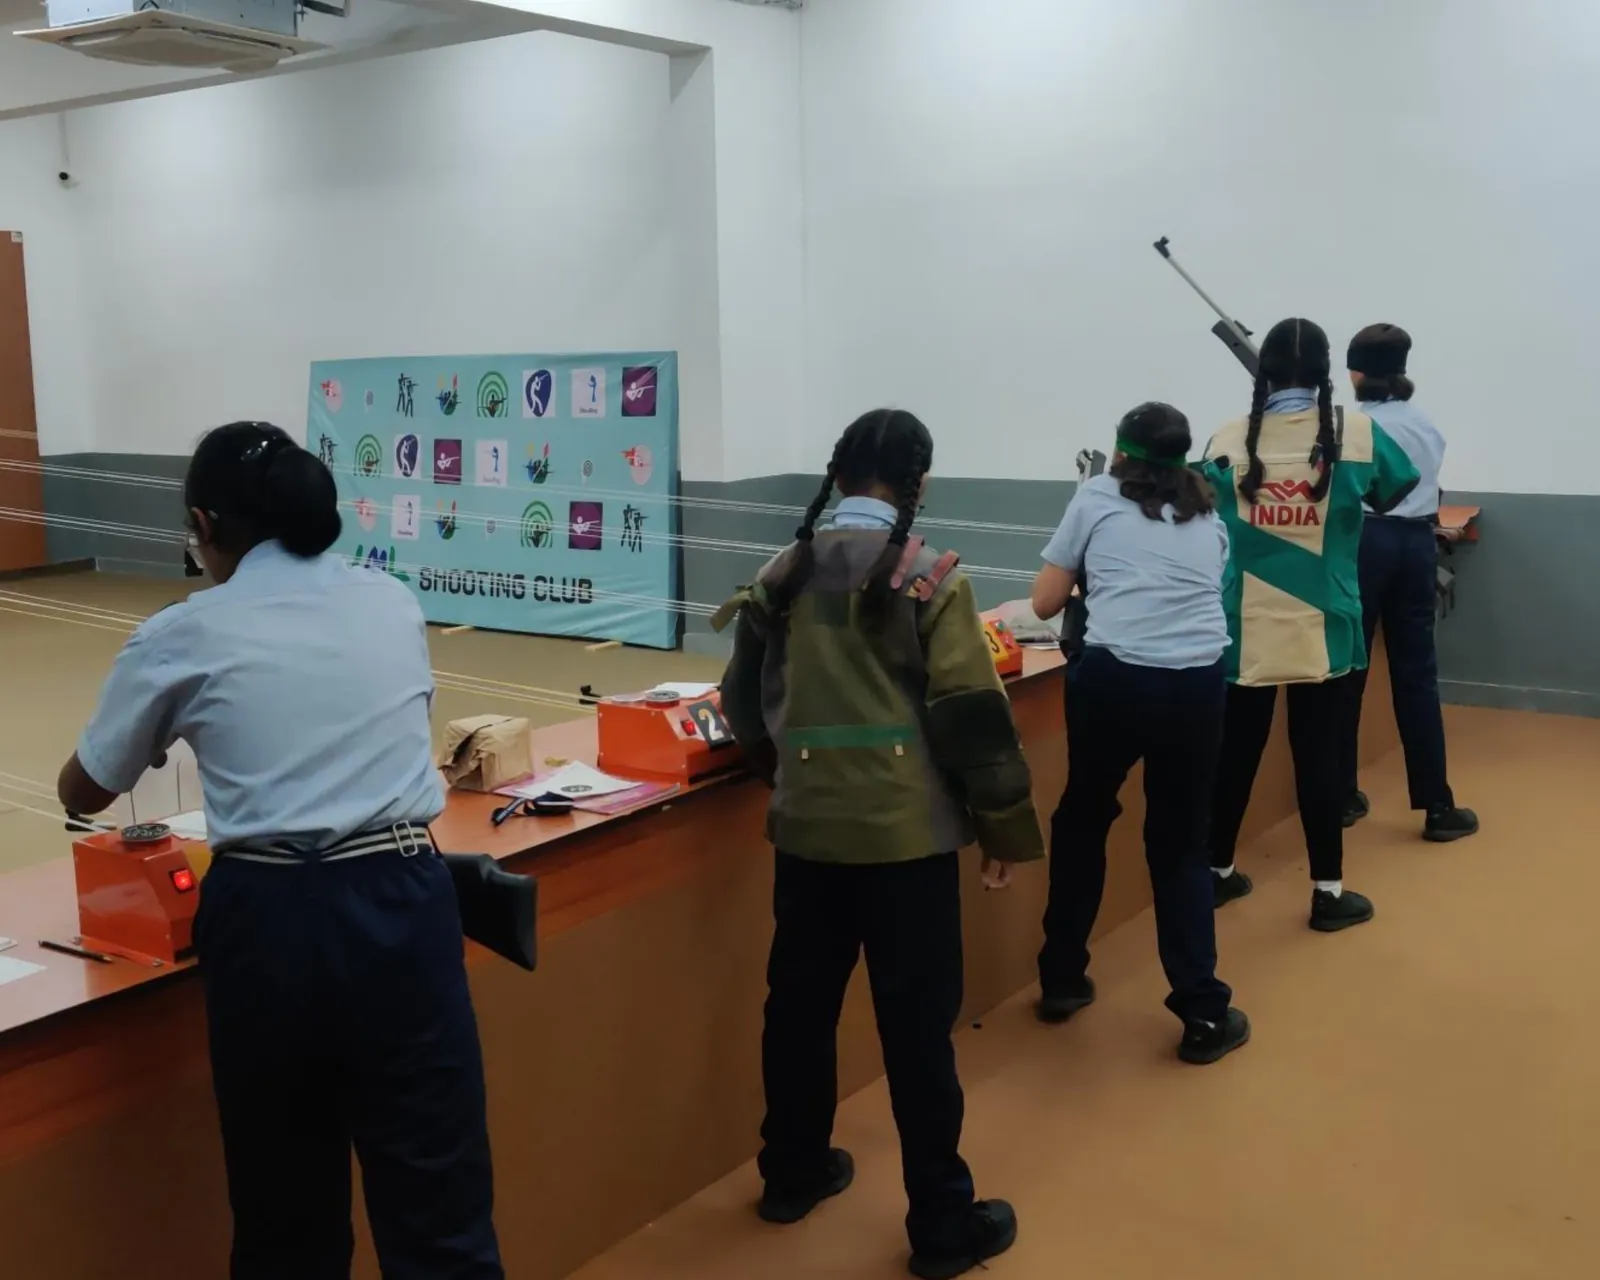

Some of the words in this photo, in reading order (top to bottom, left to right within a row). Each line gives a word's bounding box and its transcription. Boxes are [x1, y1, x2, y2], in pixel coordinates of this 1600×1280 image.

[1249, 504, 1320, 526] INDIA
[419, 566, 526, 600] SHOOTING
[533, 575, 593, 605] CLUB
[984, 627, 1001, 654] 3
[698, 708, 724, 741] 2
